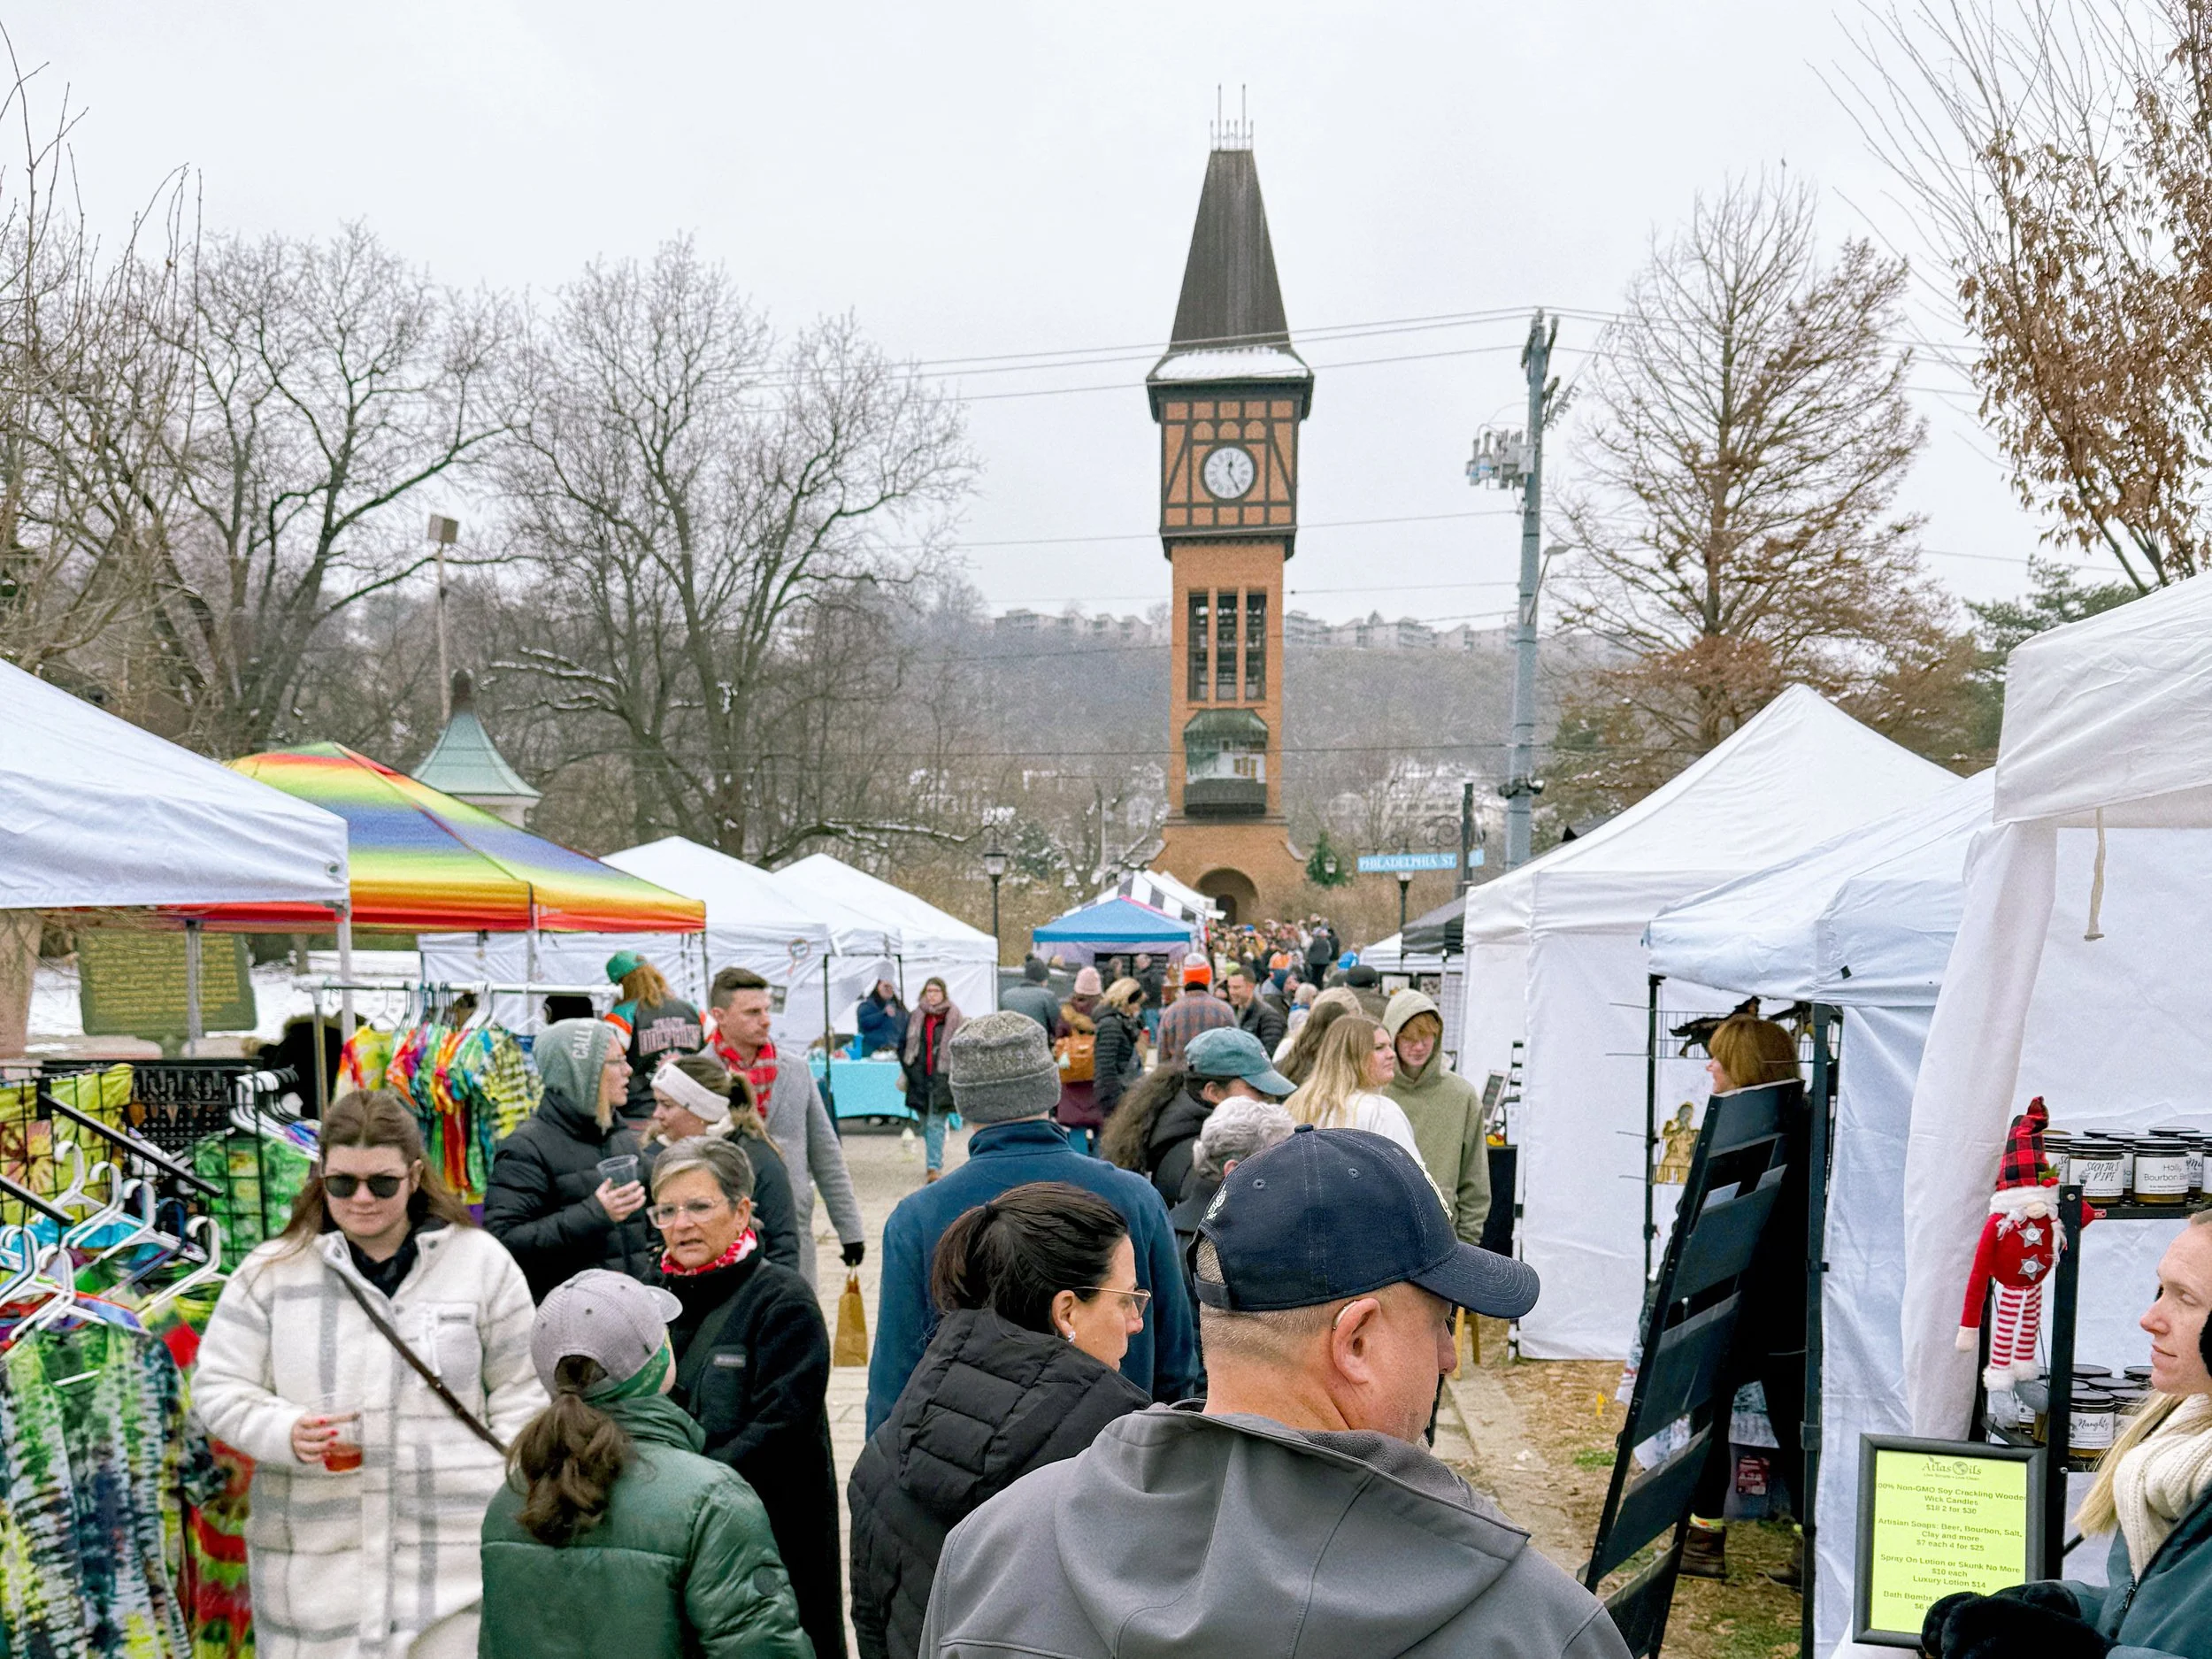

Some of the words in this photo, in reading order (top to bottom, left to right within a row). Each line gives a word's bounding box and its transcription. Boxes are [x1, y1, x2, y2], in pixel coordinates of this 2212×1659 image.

[1360, 855, 1437, 869] PHILADELPHIA
[1896, 1484, 1936, 1494] Non-GMO
[1955, 1488, 1993, 1500] Crackling
[1947, 1497, 1978, 1506] Candles
[1922, 1531, 1939, 1540] Clay
[1964, 1525, 2002, 1536] Bourbon,
[1881, 1554, 1903, 1563] Spray
[1920, 1557, 1946, 1566] Lotion
[1958, 1561, 1984, 1570] Skunk
[1913, 1575, 1941, 1585] Luxury
[1944, 1578, 1970, 1587] Lotion
[1883, 1590, 1902, 1599] Bath
[1904, 1593, 1933, 1601] Bombs
